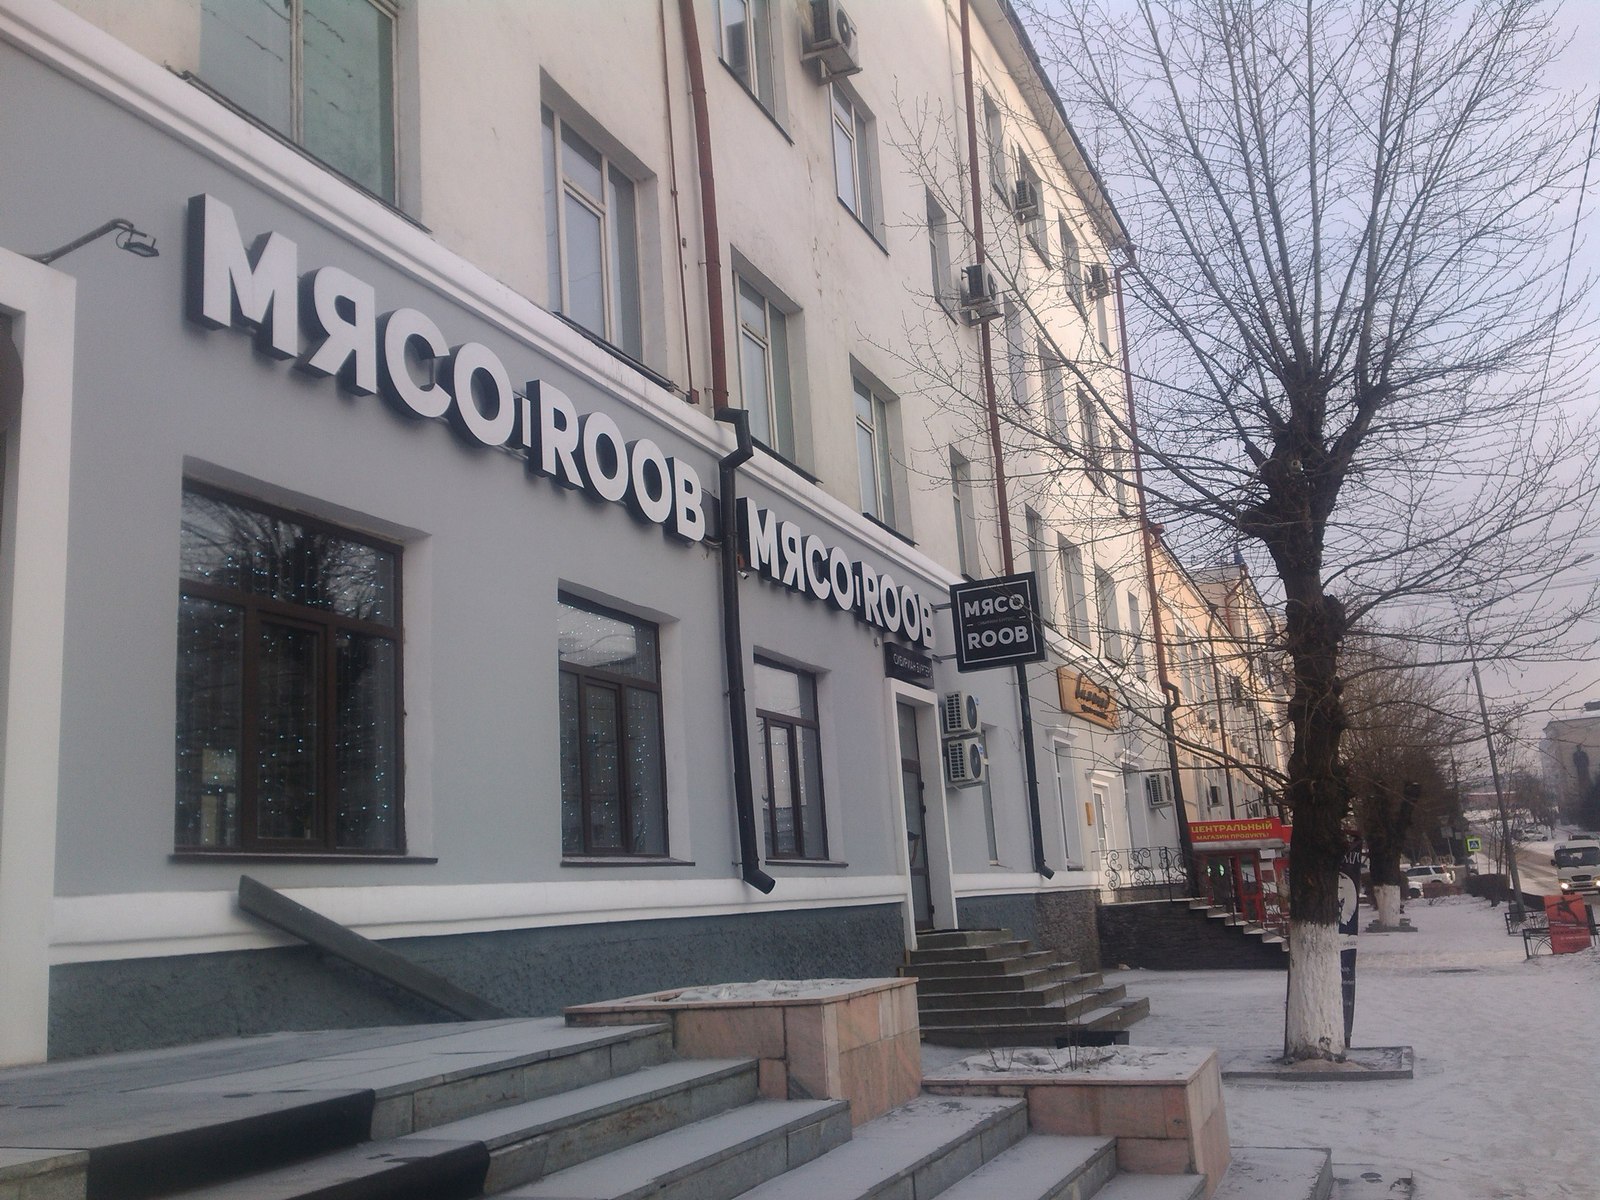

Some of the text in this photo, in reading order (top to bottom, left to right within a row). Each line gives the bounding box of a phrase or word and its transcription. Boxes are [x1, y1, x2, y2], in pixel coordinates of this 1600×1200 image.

[192, 193, 706, 542] МЯСО ROOB
[740, 497, 936, 649] МЯСО ROOB
[964, 593, 1025, 618] МЯСО
[967, 625, 1029, 650] ROOB
[1191, 820, 1273, 833] ЦЕНТРАЛЬНЫЙ
